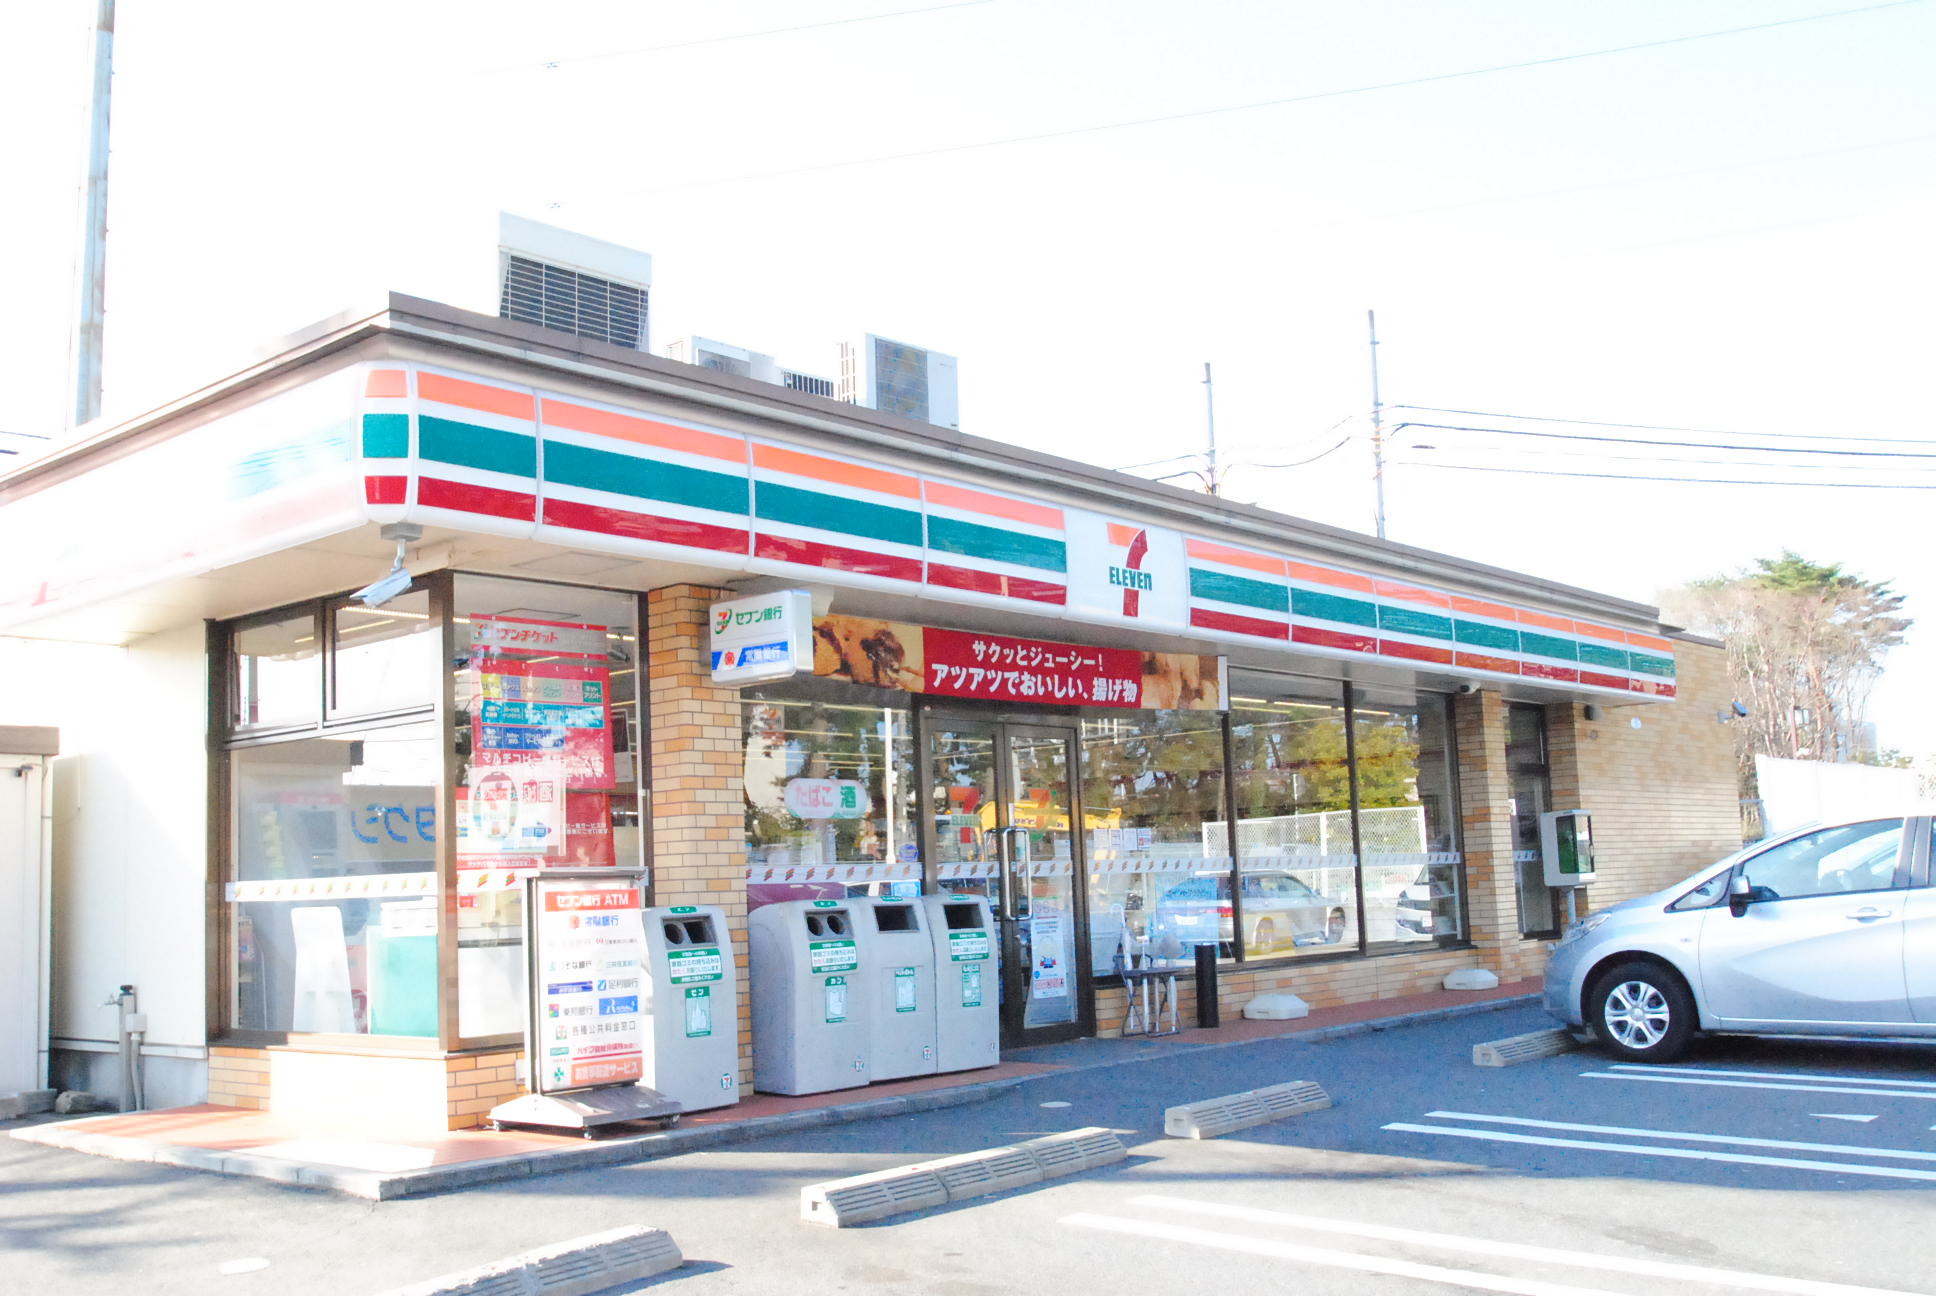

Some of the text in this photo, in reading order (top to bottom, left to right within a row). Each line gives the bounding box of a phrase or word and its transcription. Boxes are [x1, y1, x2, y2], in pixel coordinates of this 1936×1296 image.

[735, 605, 783, 626] セブン銀行
[489, 627, 559, 645] ブンチケット
[931, 662, 1138, 702] アツアツでおいしい、揚げ物
[795, 785, 857, 809] たばこ 酒
[604, 893, 629, 906] ATM
